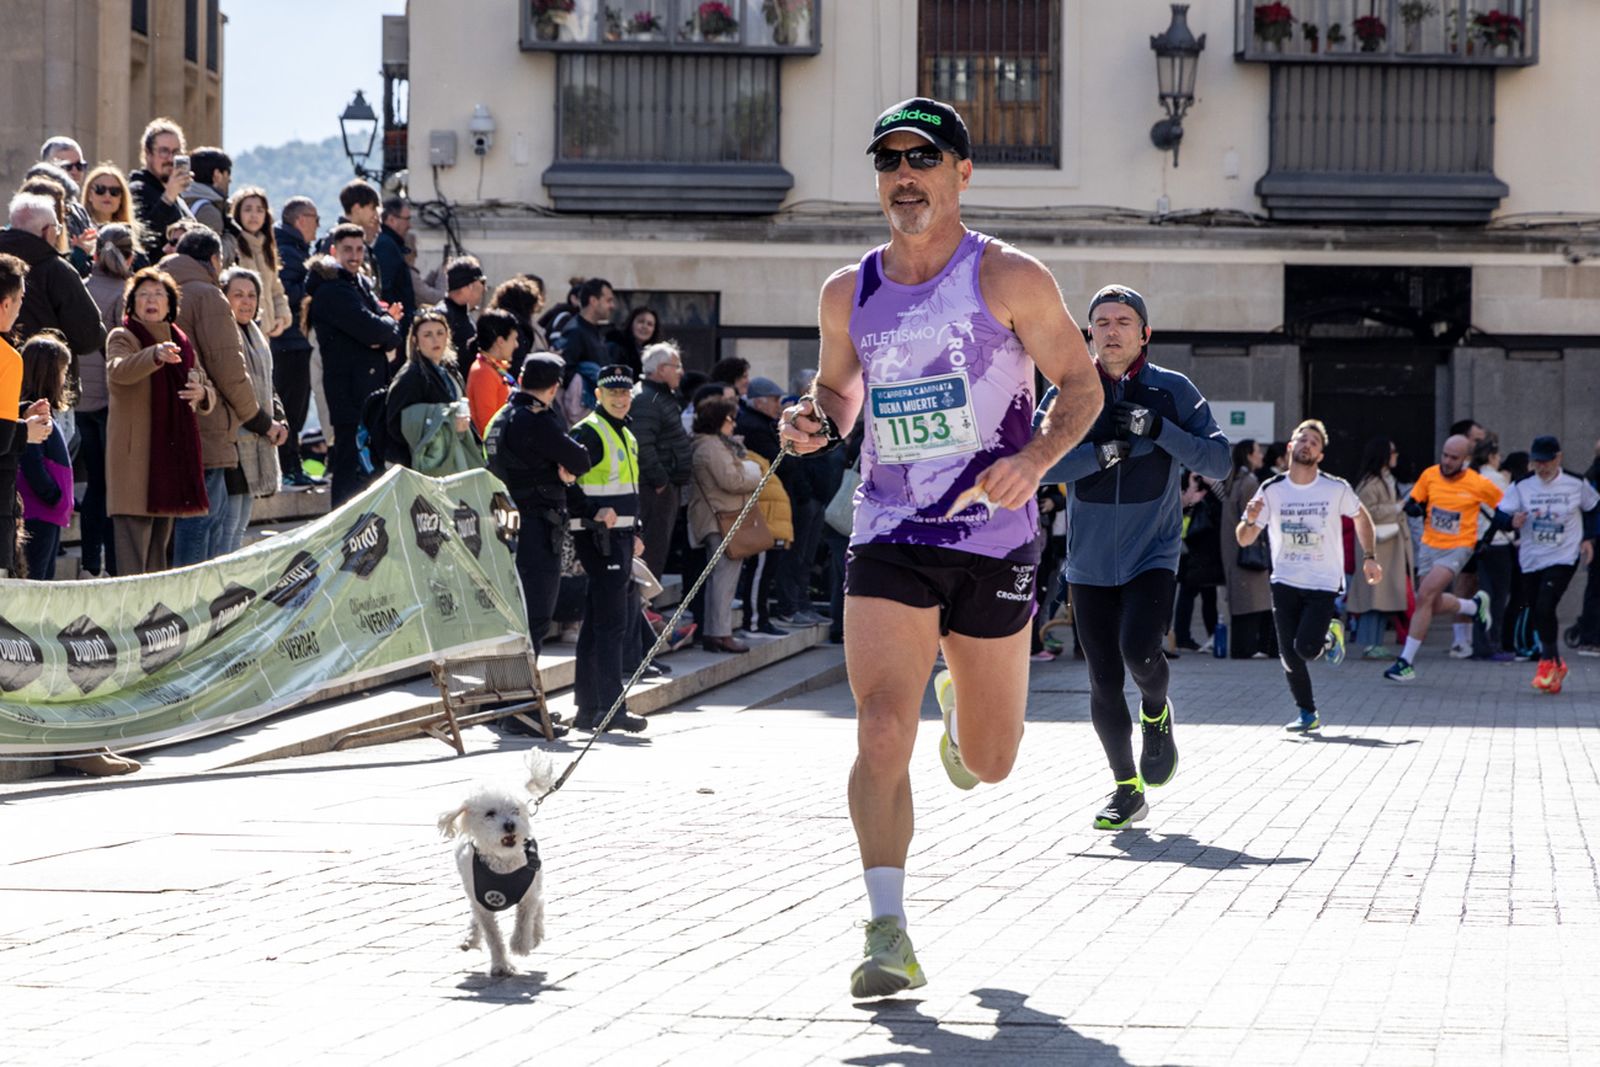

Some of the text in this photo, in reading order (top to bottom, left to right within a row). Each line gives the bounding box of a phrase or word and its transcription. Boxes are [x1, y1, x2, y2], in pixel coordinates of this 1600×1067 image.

[881, 109, 942, 126] adidas
[860, 326, 935, 349] ATLETISMO
[913, 382, 953, 395] CAMINATA
[878, 396, 938, 414] BUENA MUERTE
[888, 412, 951, 445] 1153
[1291, 533, 1309, 544] 121
